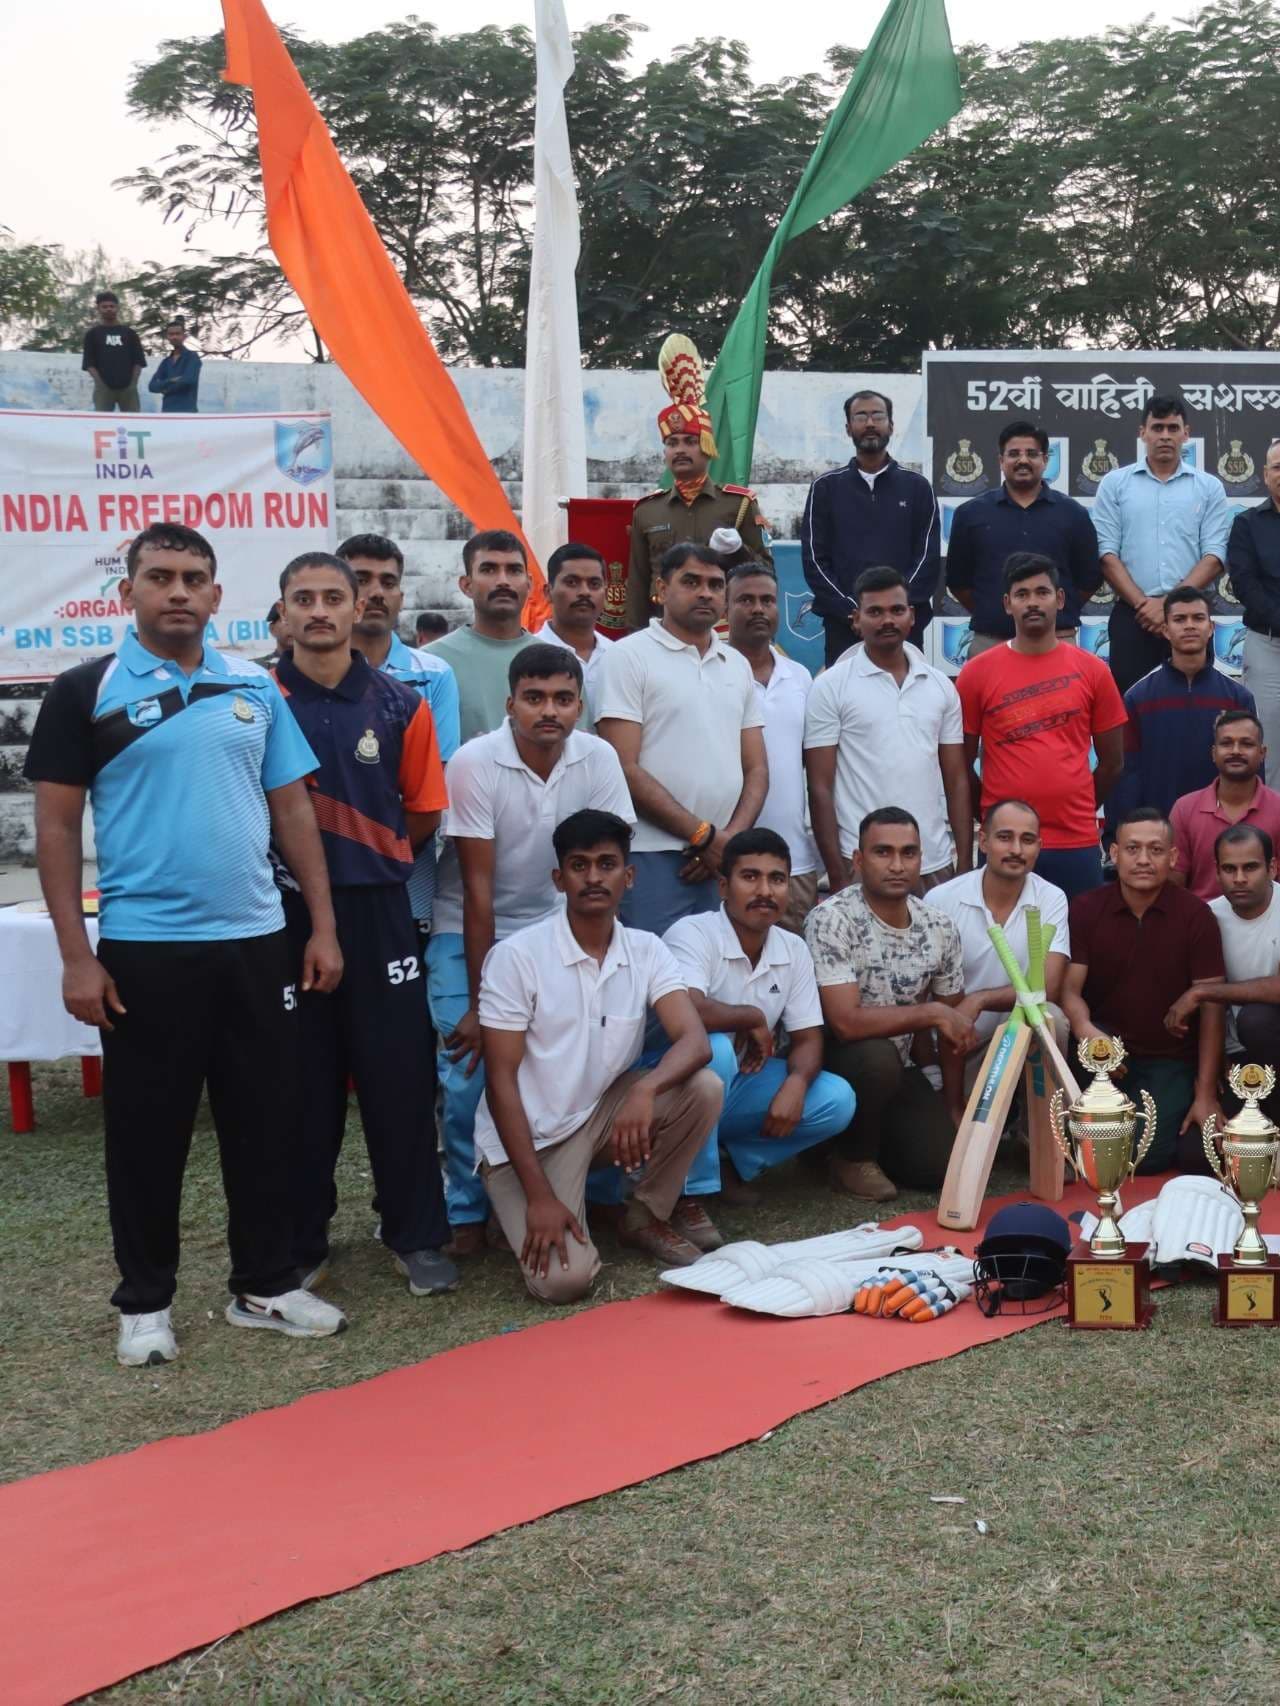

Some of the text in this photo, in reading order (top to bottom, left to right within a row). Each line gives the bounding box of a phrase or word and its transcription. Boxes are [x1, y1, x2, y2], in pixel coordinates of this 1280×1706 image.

[967, 375, 1042, 411] 52वीं
[1051, 373, 1156, 419] वाहिनी
[96, 463, 154, 480] INDIA
[956, 460, 974, 473] SSB
[1227, 461, 1245, 473] SSB
[3, 492, 329, 532] NDIA FREEDOM RUN
[95, 557, 121, 567] HUM
[105, 566, 126, 576] IND
[54, 599, 133, 619] -:ORGAN
[15, 627, 52, 650] BN
[62, 625, 113, 647] SSB
[387, 956, 420, 985] 52
[283, 984, 297, 1011] 5
[983, 1048, 1007, 1100] DECATHLON
